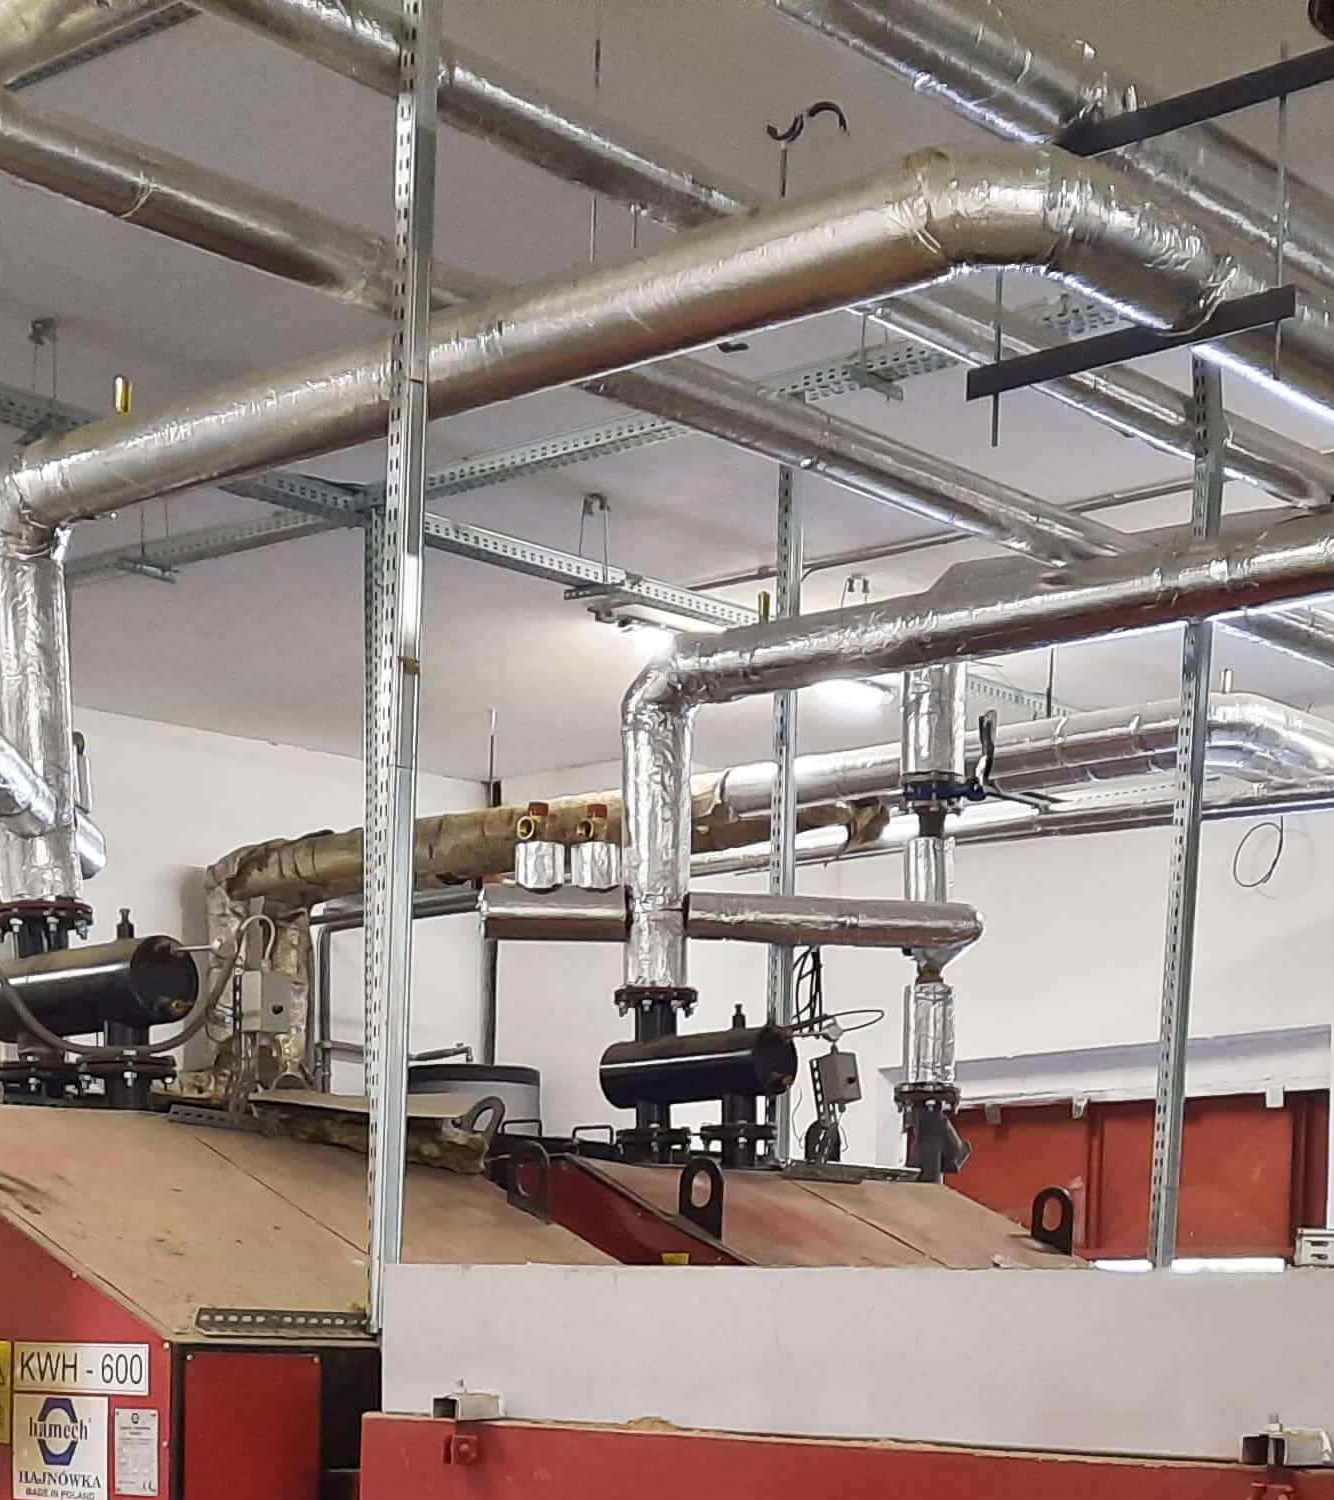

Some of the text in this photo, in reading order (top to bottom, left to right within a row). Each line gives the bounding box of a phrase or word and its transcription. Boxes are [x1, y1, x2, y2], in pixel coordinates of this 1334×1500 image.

[20, 1351, 78, 1383] KWH
[101, 1353, 143, 1385] 600
[29, 1417, 88, 1440] hamech
[19, 1470, 101, 1488] HAJNÓWKA
